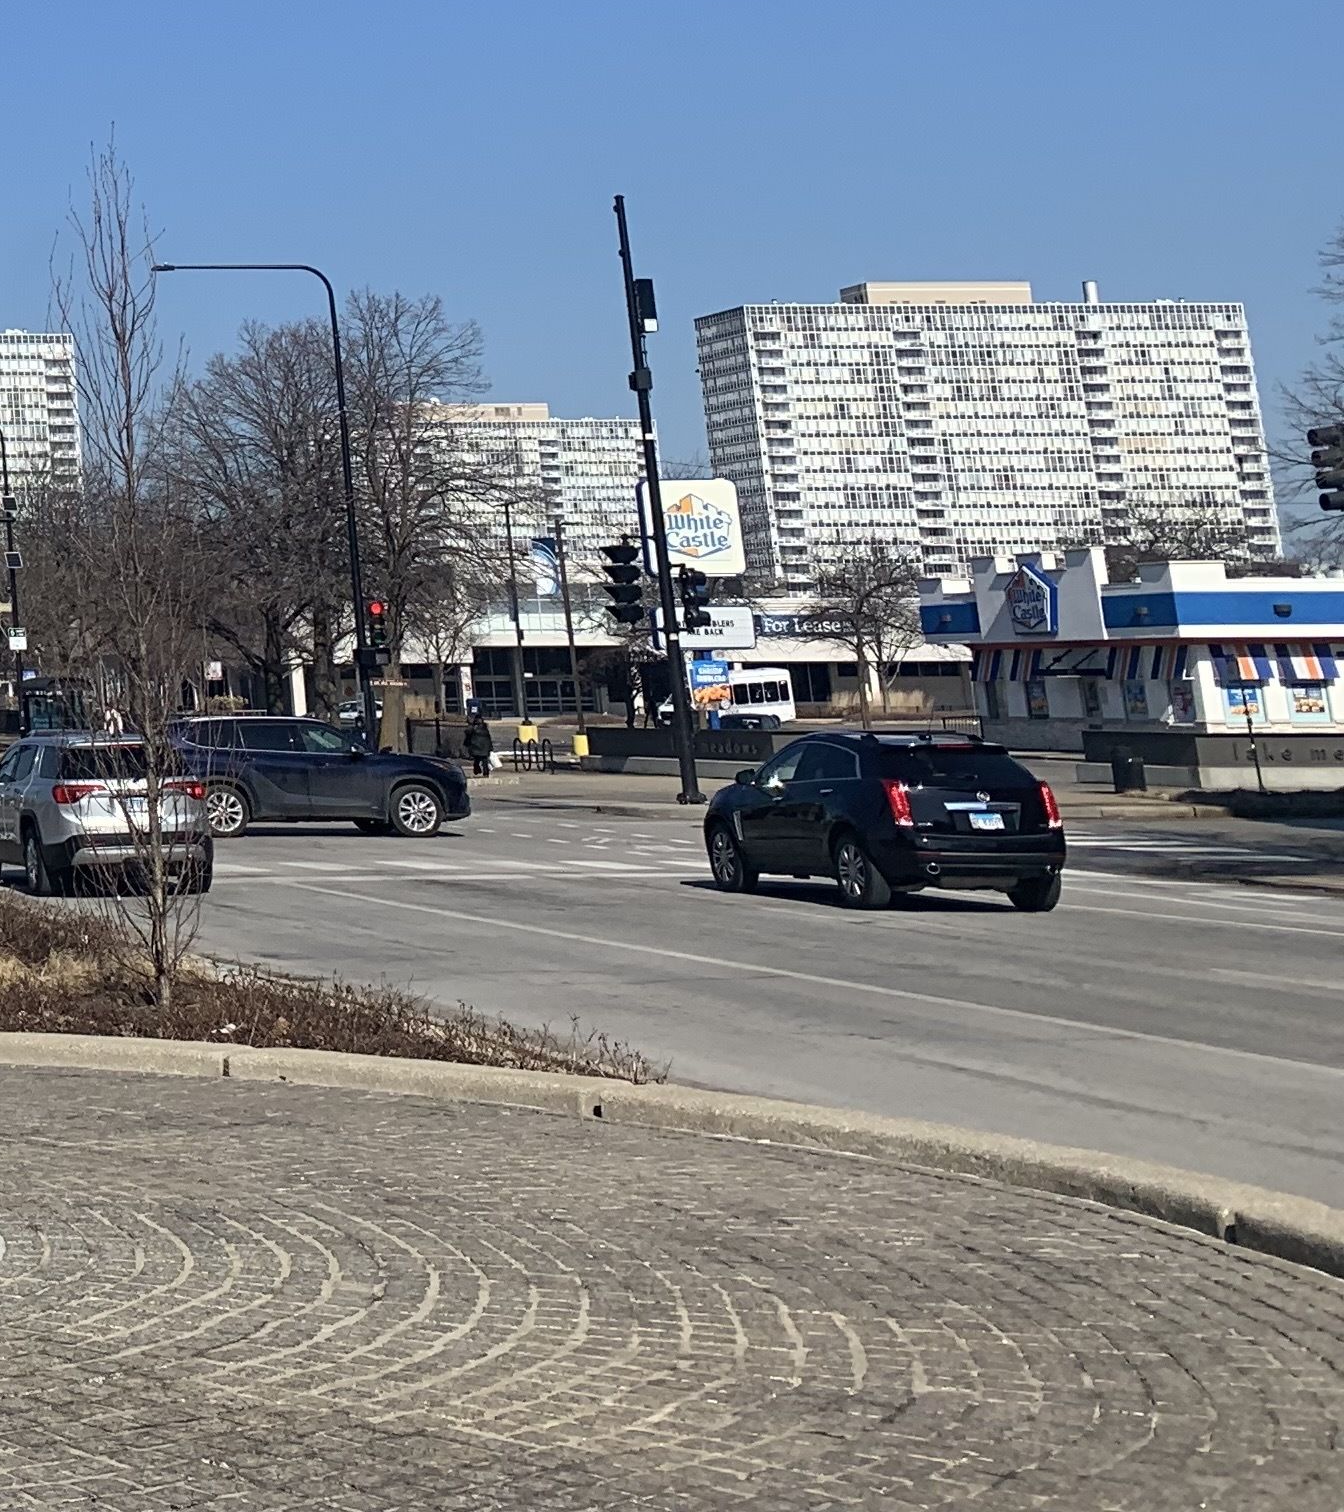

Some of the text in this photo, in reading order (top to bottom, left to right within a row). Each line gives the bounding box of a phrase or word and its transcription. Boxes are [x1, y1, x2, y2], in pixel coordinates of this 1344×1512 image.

[666, 513, 724, 533] White
[666, 531, 728, 549] Castle
[1012, 589, 1042, 606] White
[1012, 604, 1045, 620] Castle
[704, 628, 724, 636] BACK
[762, 617, 790, 633] For
[792, 617, 841, 633] Lease
[1232, 741, 1293, 762] lake
